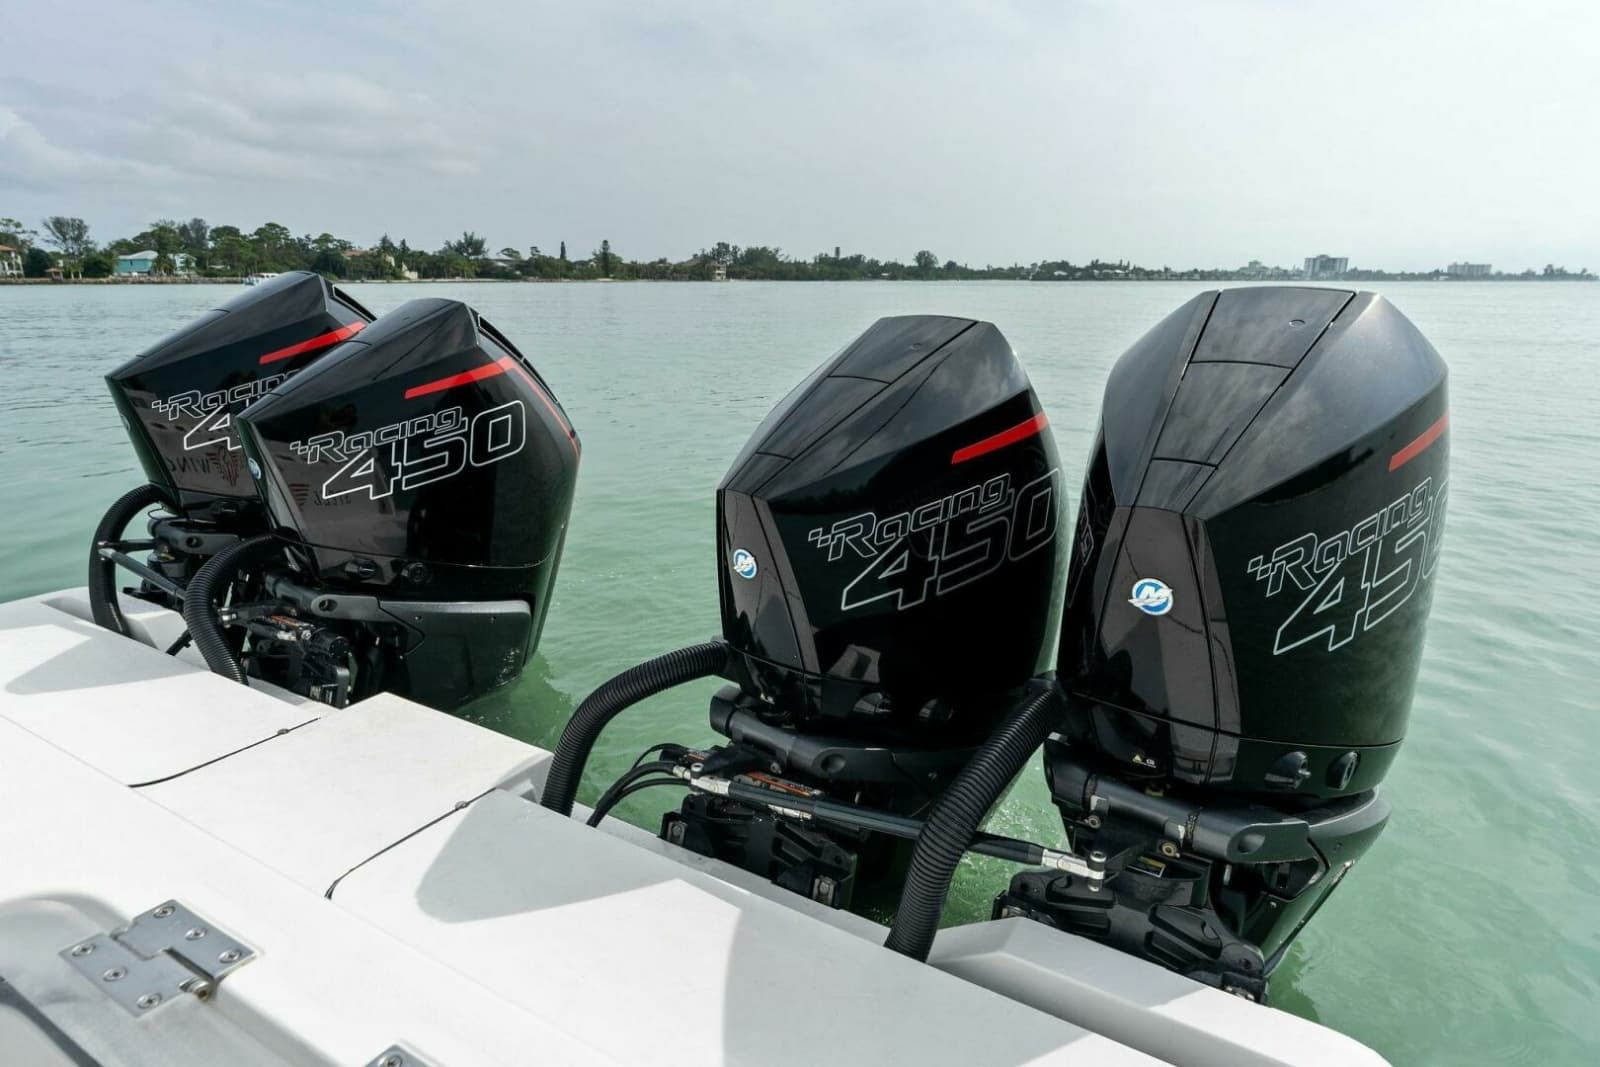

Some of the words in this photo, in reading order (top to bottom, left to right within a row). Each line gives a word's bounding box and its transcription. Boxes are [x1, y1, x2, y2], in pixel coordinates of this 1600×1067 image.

[168, 368, 300, 421] Racin
[308, 406, 464, 464] Racing
[323, 400, 526, 500] 450
[828, 472, 1011, 562] Racing
[841, 468, 1060, 611] 450
[1266, 476, 1432, 598] Racing
